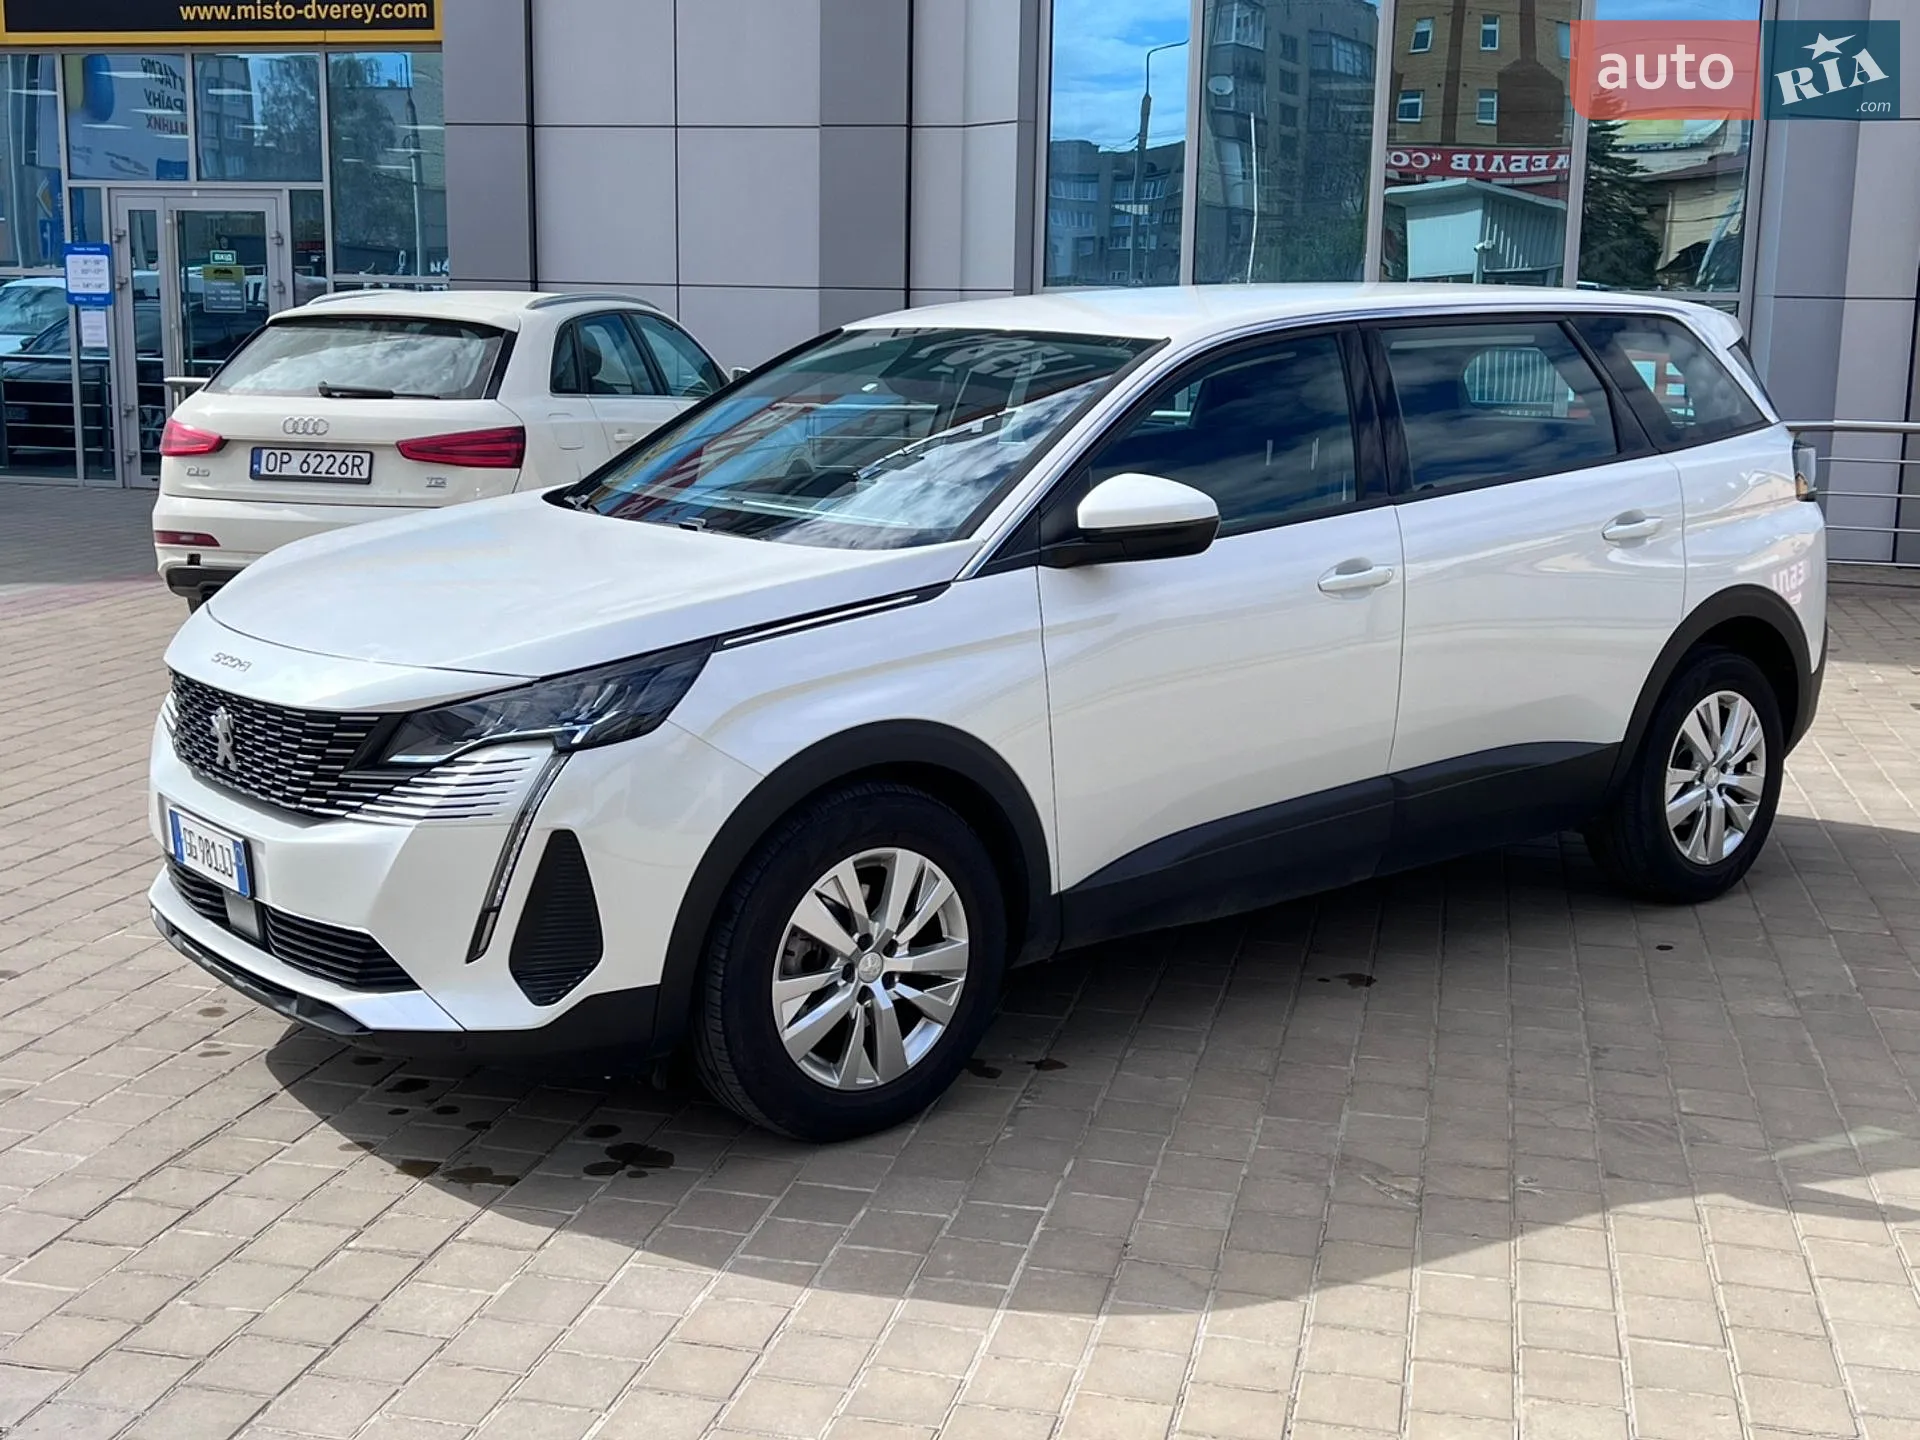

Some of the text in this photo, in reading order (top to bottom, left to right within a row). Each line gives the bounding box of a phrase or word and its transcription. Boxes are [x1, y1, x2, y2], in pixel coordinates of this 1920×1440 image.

[179, 0, 427, 24] www.misto-dverey.com
[265, 451, 364, 476] OP 6226R
